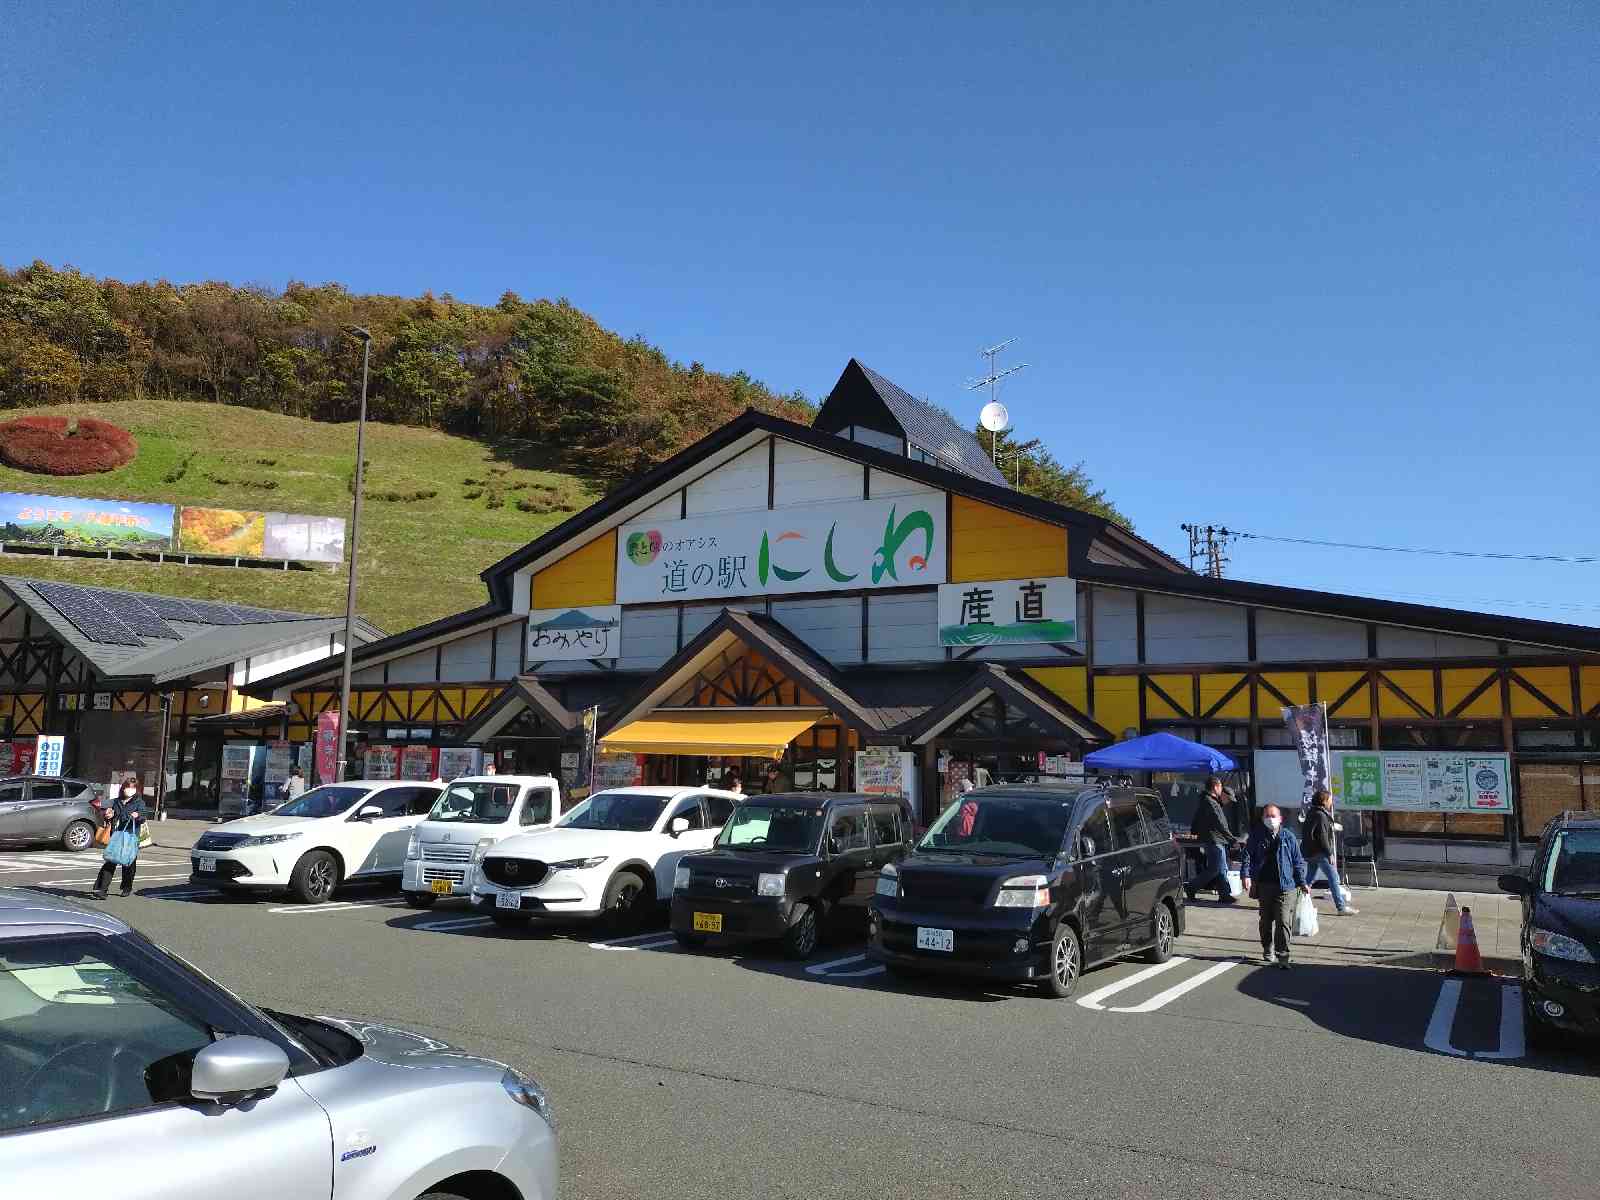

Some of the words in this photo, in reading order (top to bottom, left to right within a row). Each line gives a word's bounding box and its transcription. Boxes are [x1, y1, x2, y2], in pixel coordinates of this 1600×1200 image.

[661, 556, 747, 594] 道の駅
[758, 503, 935, 587] にしね
[960, 580, 1053, 625] 産直
[532, 615, 616, 656] おみやげ
